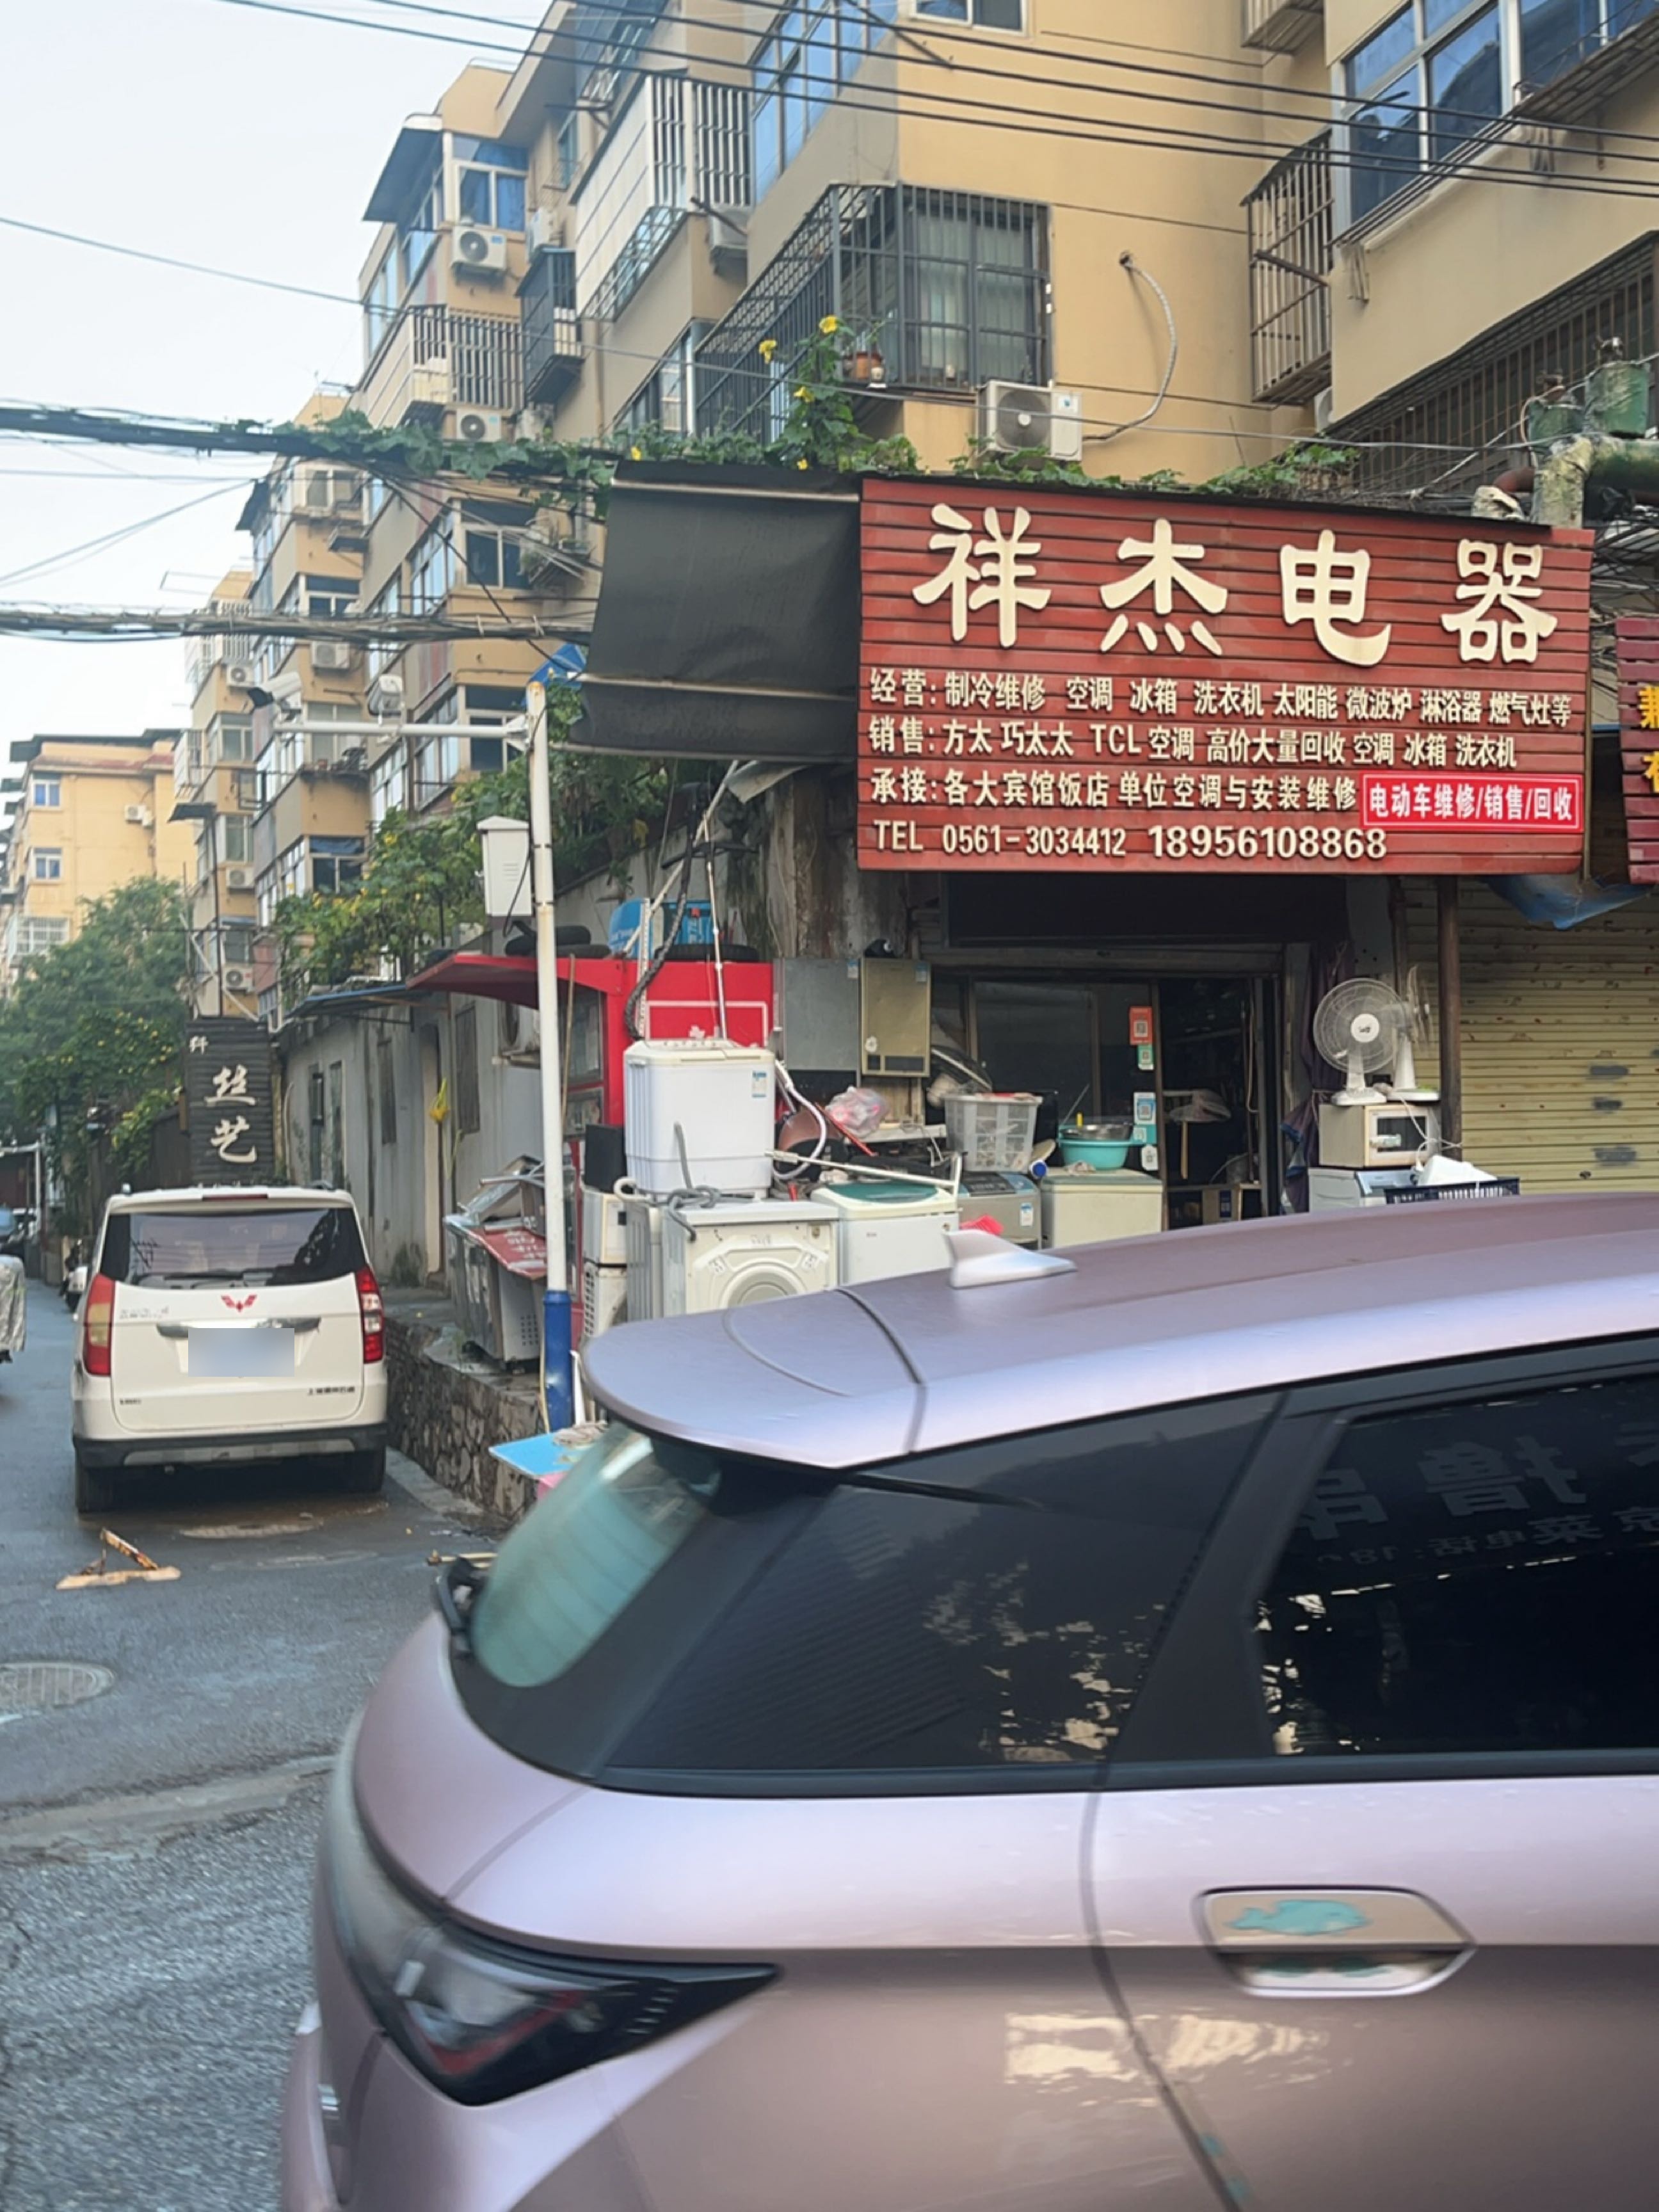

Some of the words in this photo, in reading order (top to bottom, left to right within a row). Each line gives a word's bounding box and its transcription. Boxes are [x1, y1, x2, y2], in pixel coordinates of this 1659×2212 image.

[912, 503, 1558, 666] 祥杰电器
[1066, 675, 1113, 711] 空调
[1129, 678, 1177, 715] 冰箱
[1194, 680, 1265, 717] 洗衣机
[1272, 682, 1338, 720] 太阳能
[1346, 686, 1412, 722] 微波炉
[1420, 689, 1482, 723] 淋浴器
[1488, 691, 1572, 728] 燃气灶等
[1000, 720, 1075, 757] 巧太太
[1089, 724, 1142, 754] TCL
[1148, 725, 1194, 762] 空调
[1206, 726, 1346, 764] 高价大量回收
[1352, 731, 1395, 765] 空调
[1402, 732, 1447, 767] 冰箱
[1455, 733, 1517, 768] 洗衣机
[1369, 782, 1572, 822] 电动车维修/销售/回收
[874, 819, 924, 851] TEL
[942, 824, 1126, 856] 0561-3034412
[1147, 824, 1387, 860] 18956108868
